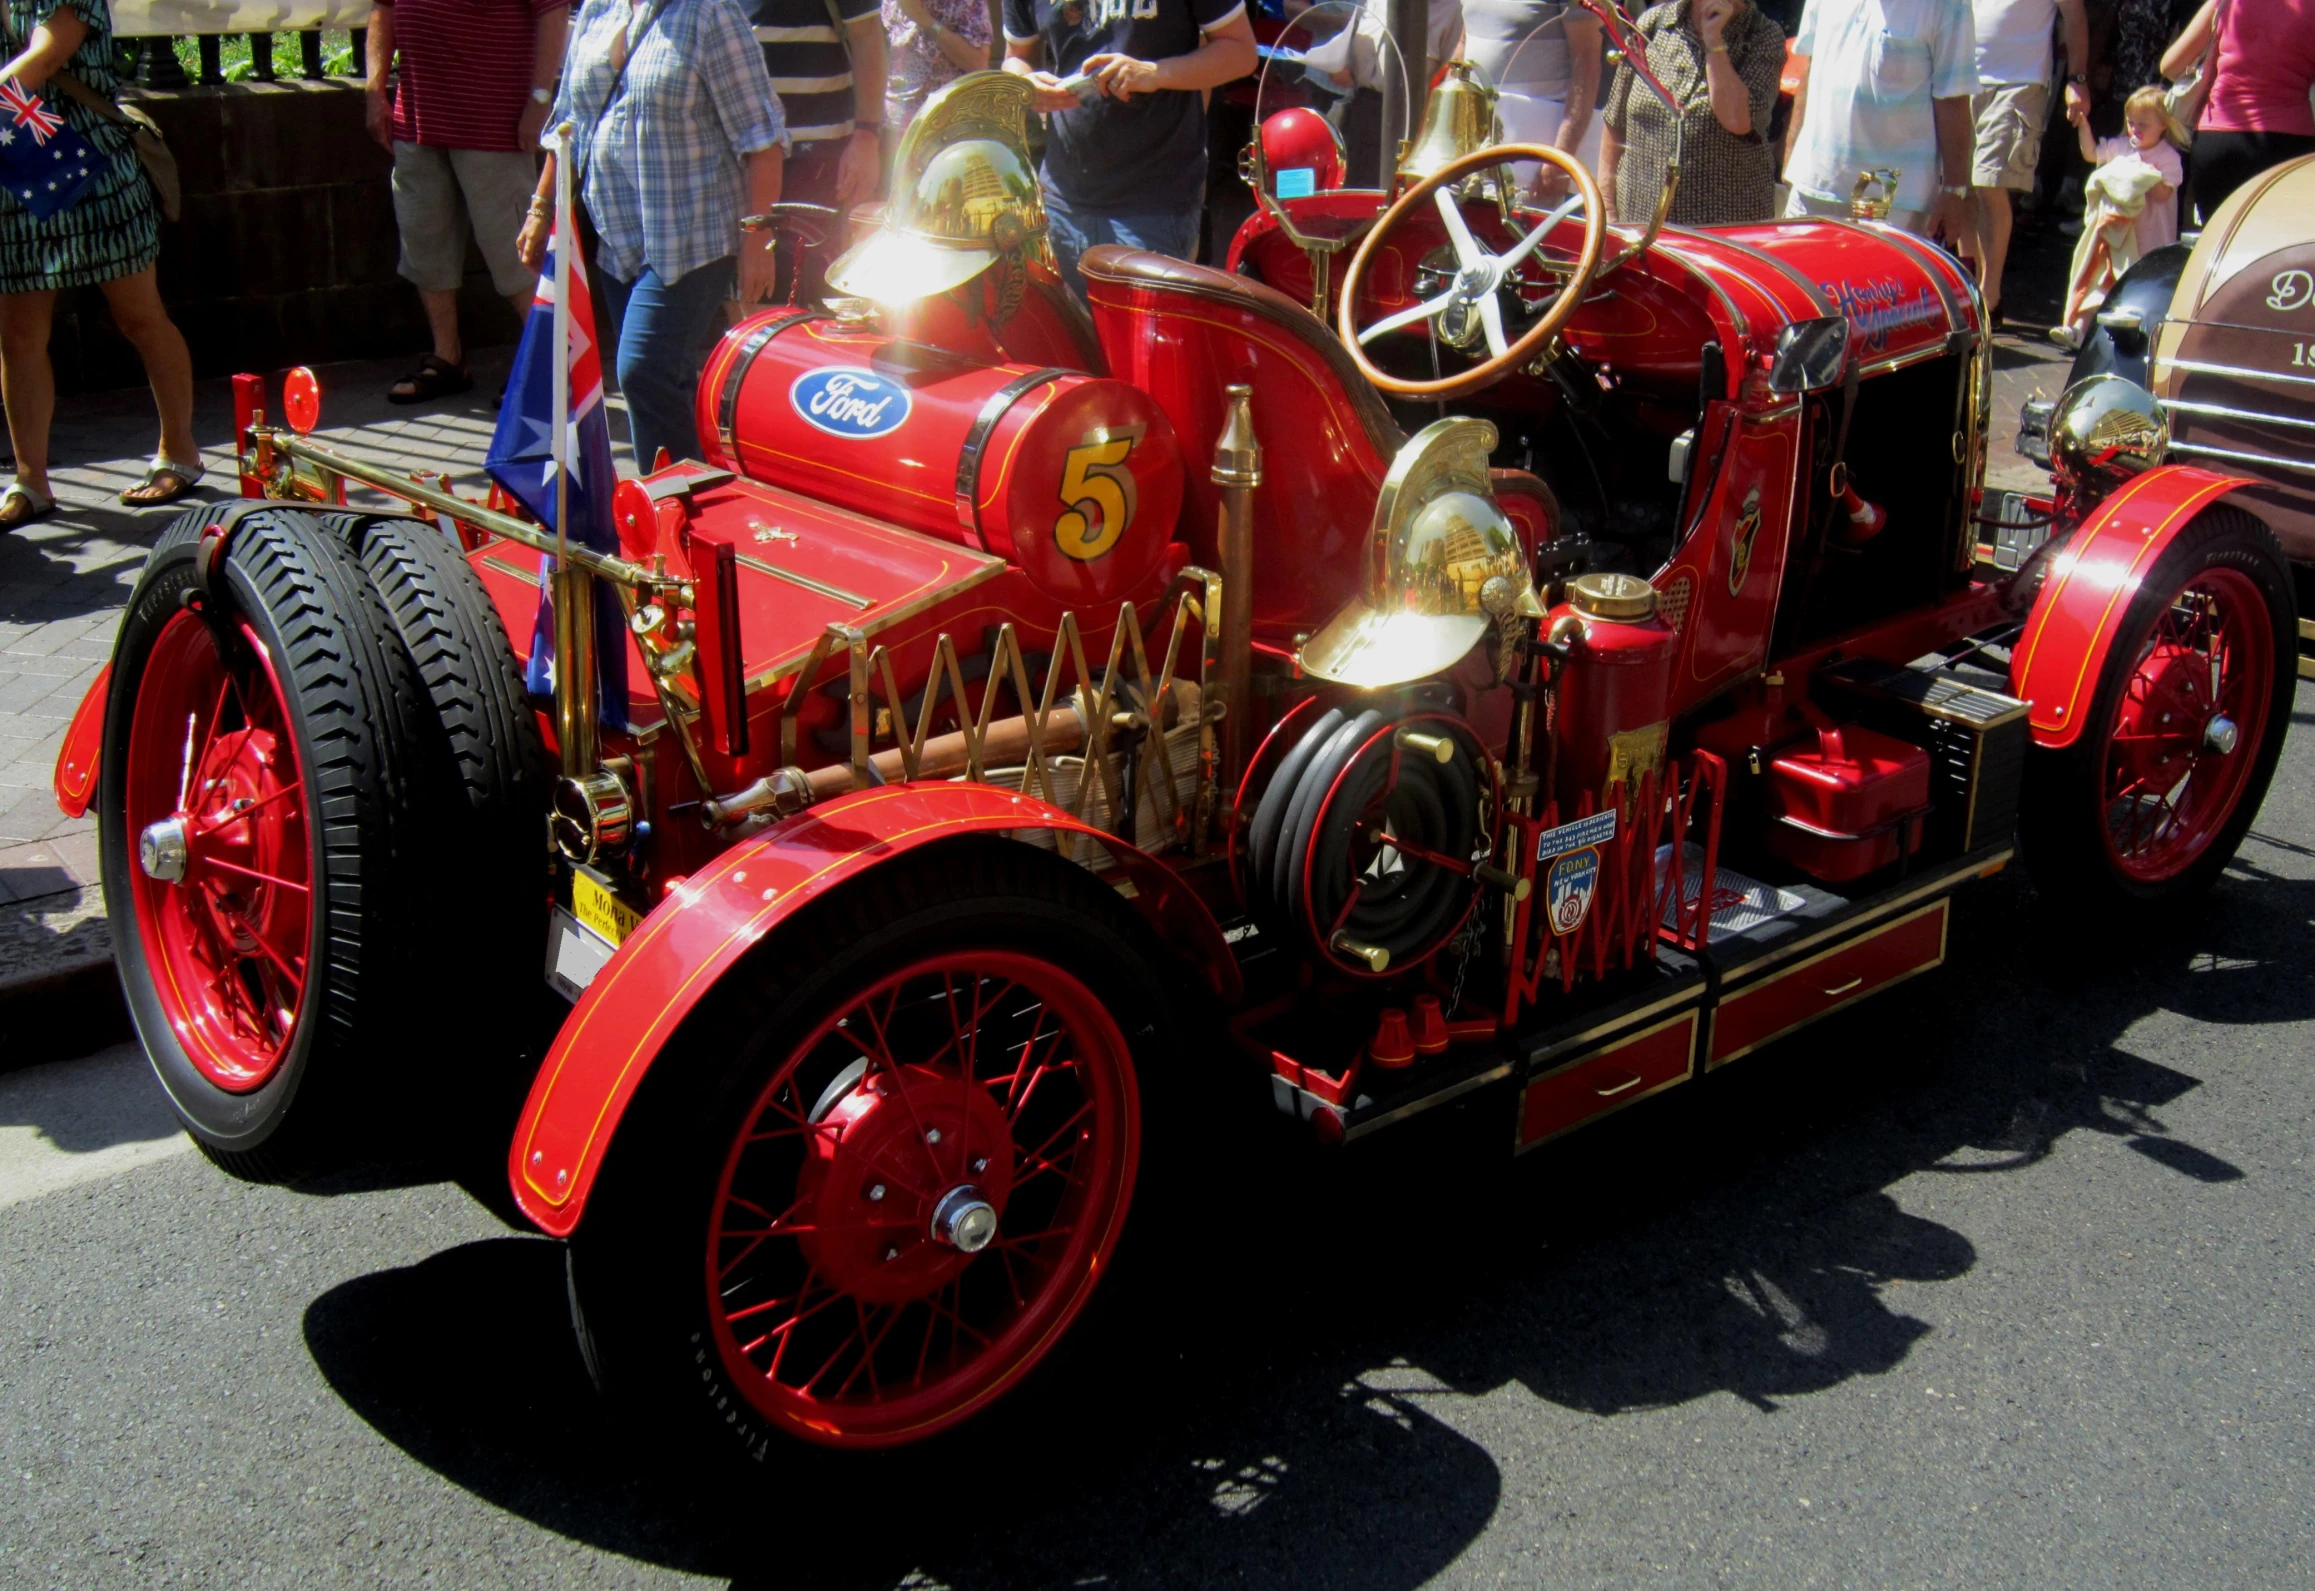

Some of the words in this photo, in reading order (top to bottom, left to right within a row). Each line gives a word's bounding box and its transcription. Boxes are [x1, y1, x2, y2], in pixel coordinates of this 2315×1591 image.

[2265, 269, 2315, 311] D
[1861, 286, 1940, 354] Special
[810, 373, 893, 428] Ford
[1053, 435, 1135, 562] 5
[1542, 830, 1556, 840] THIS
[1558, 822, 1582, 835] VEHICLE
[1583, 820, 1589, 828] IS
[1552, 837, 1563, 846] THE
[1542, 846, 1556, 857] DIED
[1557, 844, 1564, 852] IN
[1565, 841, 1576, 849] THE
[1554, 877, 1570, 887] NEW
[1571, 871, 1586, 880] YORK
[1586, 866, 1597, 875] CITY
[579, 901, 592, 917] The
[592, 889, 625, 927] Mona
